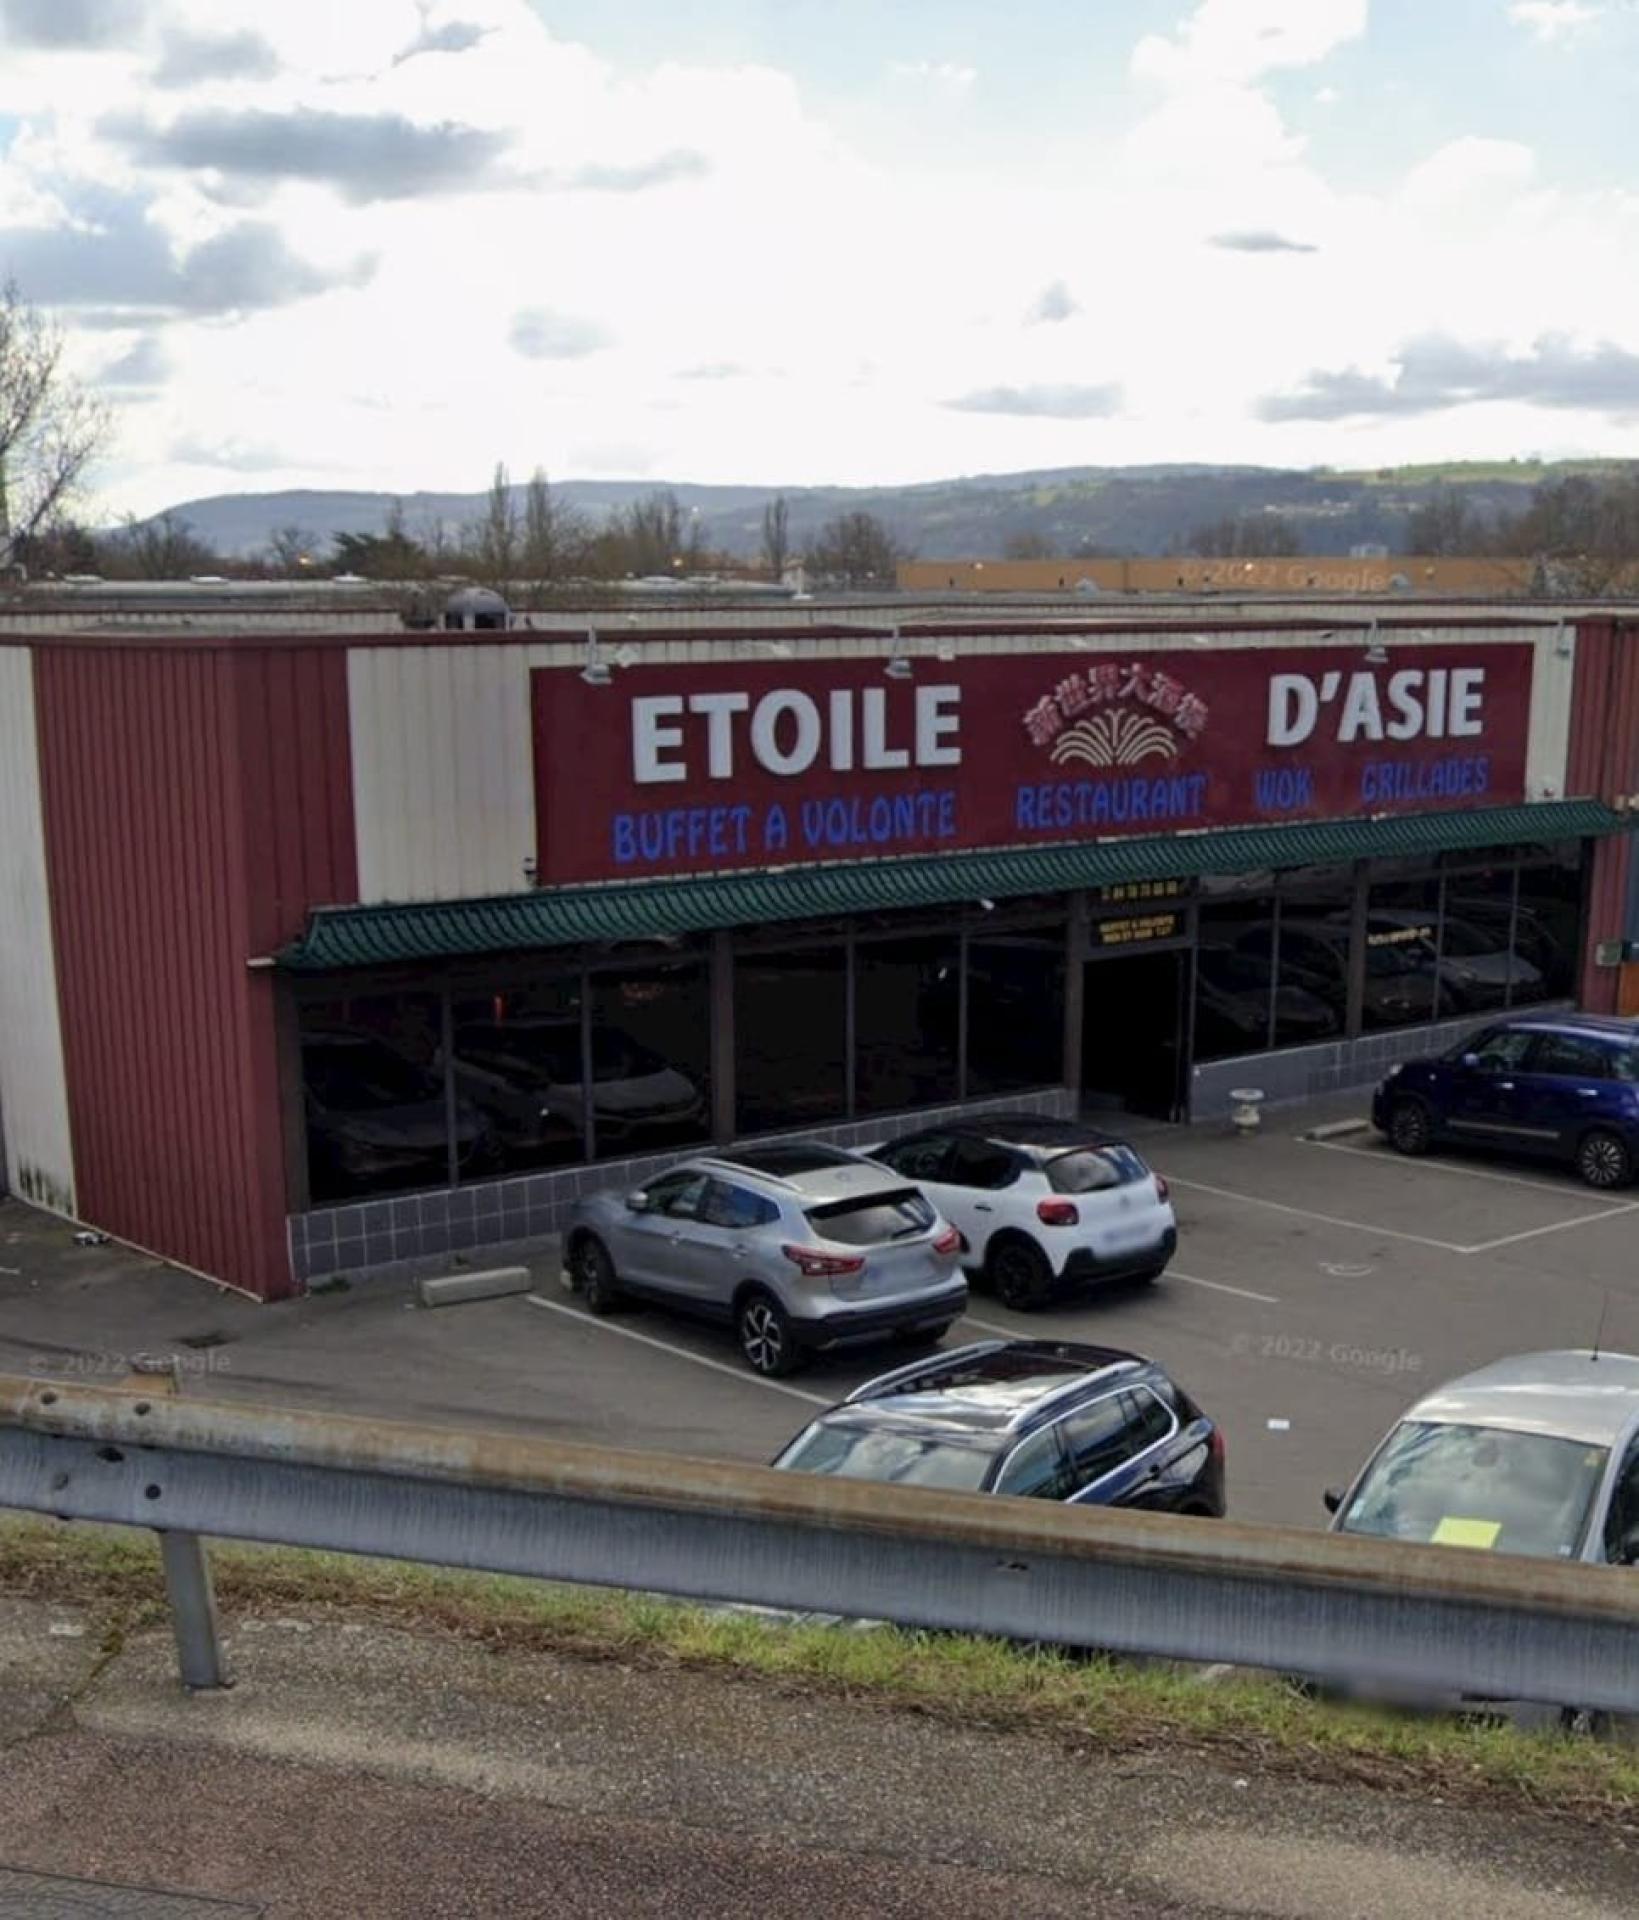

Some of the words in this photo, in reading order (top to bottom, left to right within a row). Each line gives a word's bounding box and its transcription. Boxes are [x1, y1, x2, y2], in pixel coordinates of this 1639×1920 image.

[631, 685, 962, 783] ETOILE
[1267, 667, 1486, 747] D'ASIE
[612, 804, 752, 864] BUFFET
[802, 791, 957, 846] VOLONTE
[1015, 774, 1207, 831] RESTAURANT
[1255, 768, 1313, 812] WOK
[1361, 757, 1489, 803] GRILLADES
